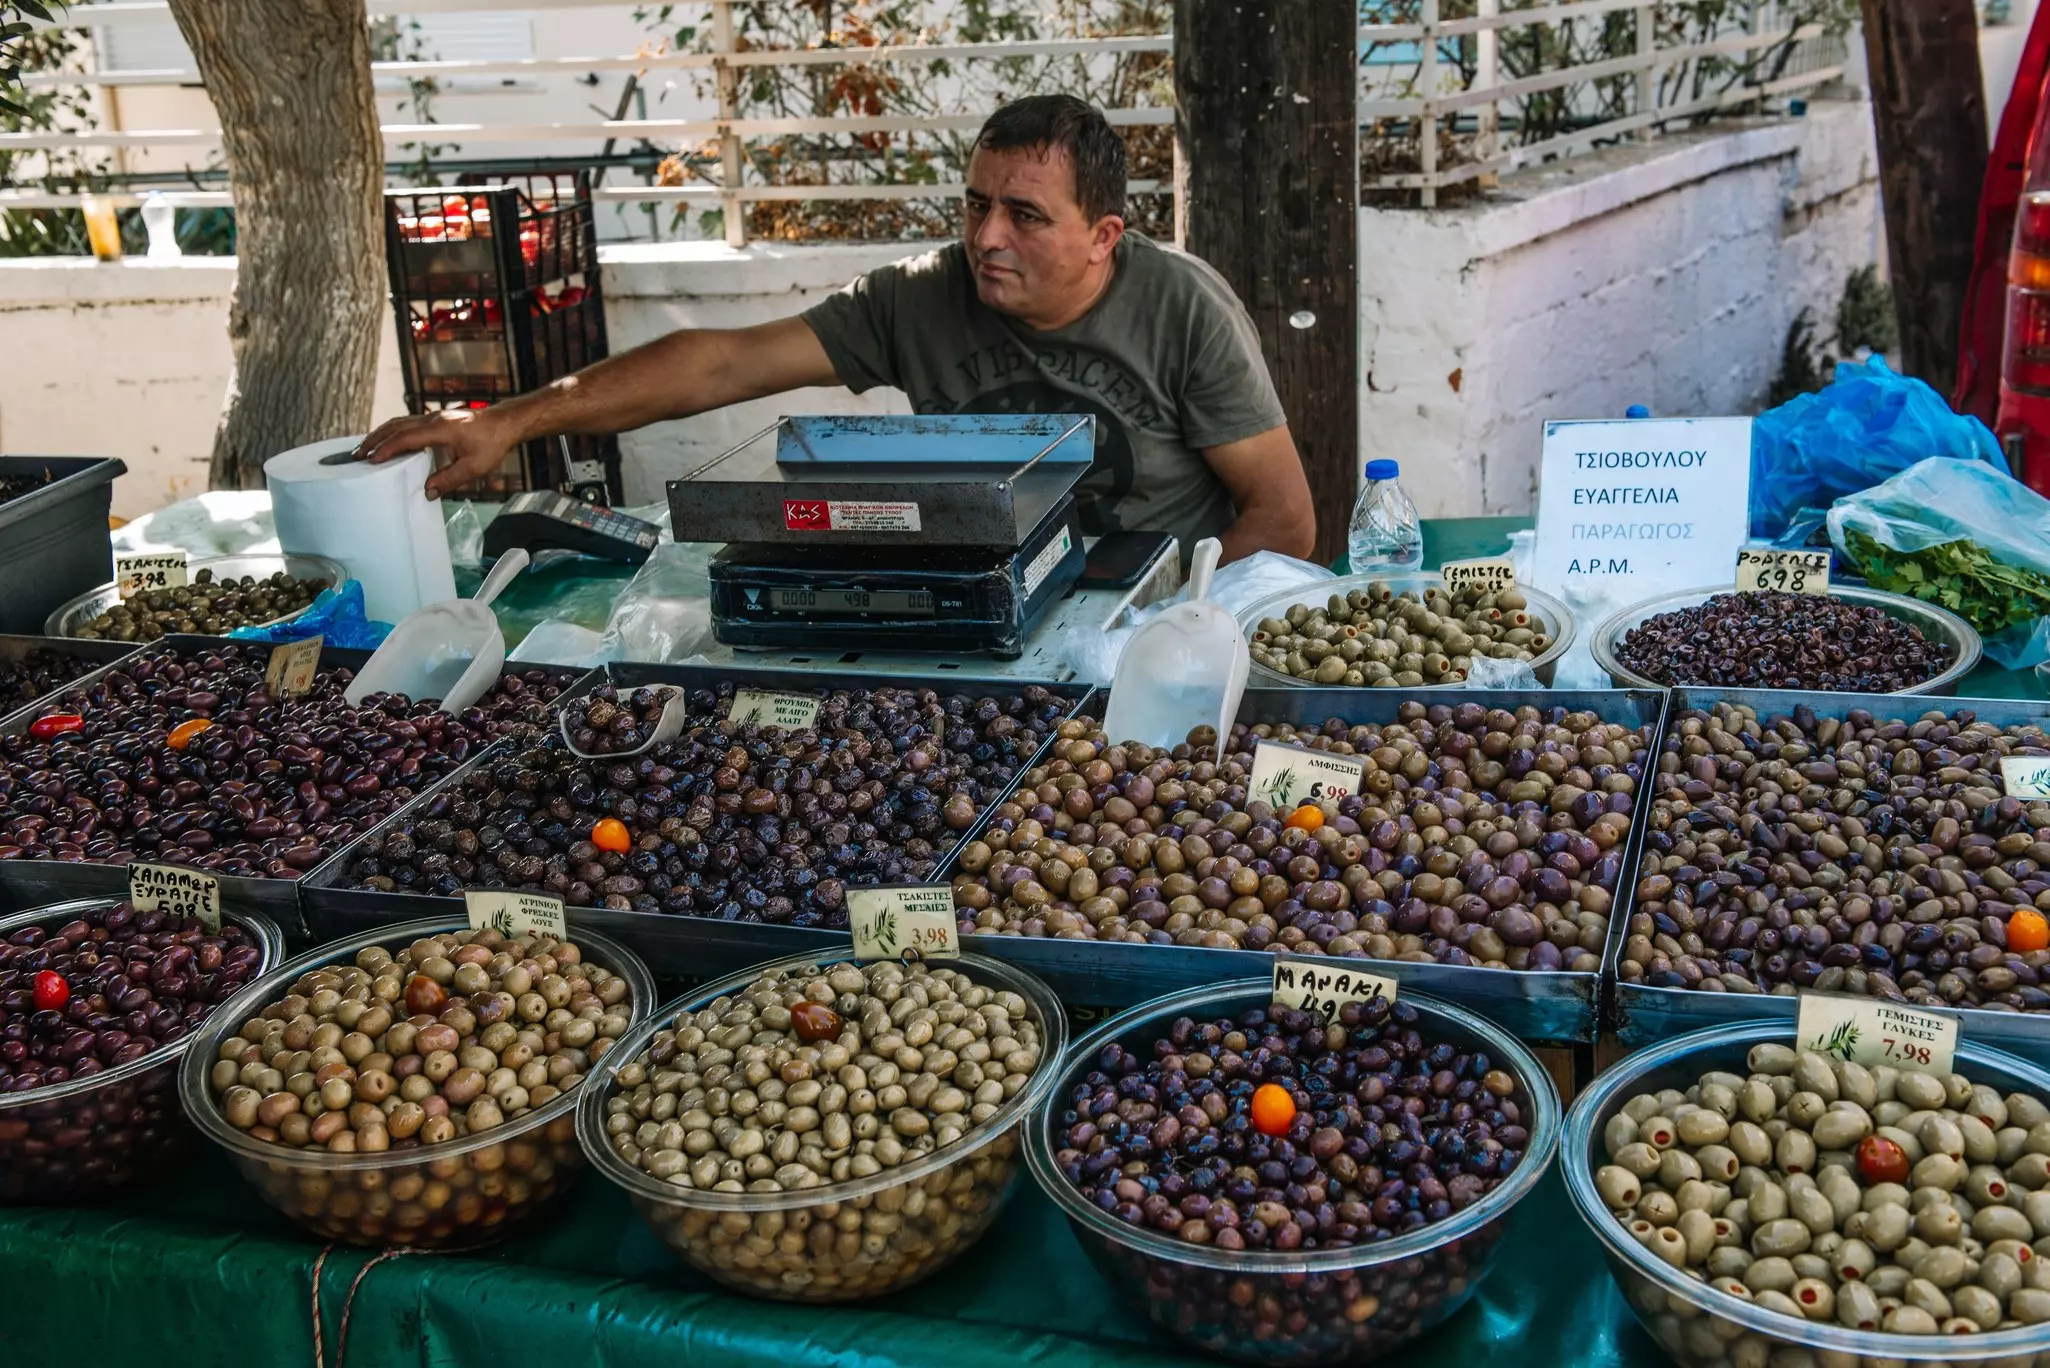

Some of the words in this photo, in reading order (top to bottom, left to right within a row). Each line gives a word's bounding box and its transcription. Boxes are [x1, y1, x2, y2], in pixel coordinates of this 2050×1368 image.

[957, 338, 1022, 386] VIS
[1033, 350, 1162, 432] PACEM
[1574, 450, 1708, 469] ΤΣΙΟΒΟΥΛΟΥ
[1573, 487, 1680, 505] ΕΥΑΓΓΕΛΙΑ
[1571, 522, 1695, 540] ΠΑΡΑΓΩΓΟΣ
[1567, 558, 1635, 575] Α.Ρ.Μ.
[941, 600, 963, 608] DS-781
[774, 697, 815, 709] ΘΡΟΥΜΠΑ
[775, 706, 787, 715] ΜΕ
[787, 708, 809, 717] ΛΙΓΟ
[776, 716, 802, 725] ΑΛΑΤΙ
[1308, 759, 1360, 776] ΑΜΦΙΣΣΗΣ
[518, 897, 559, 910] ΑΓΡΙΝΙΟΥ
[896, 891, 952, 902] ΤΣΑΚΙΣΤΕΣ
[521, 907, 560, 920] ΦΡΕΣΚΕΣ
[904, 903, 948, 913] ΜΕΣΑΙΕΣ
[530, 918, 554, 928] ΛΟΥΞ
[1275, 965, 1383, 997] ΜΑΝΑΚΙ
[1877, 1008, 1944, 1031] ΓΕΜΙΣΤΕΣ
[1882, 1021, 1936, 1042] ΓΛΥΚΕΣ
[1882, 1038, 1932, 1066] 7,98
